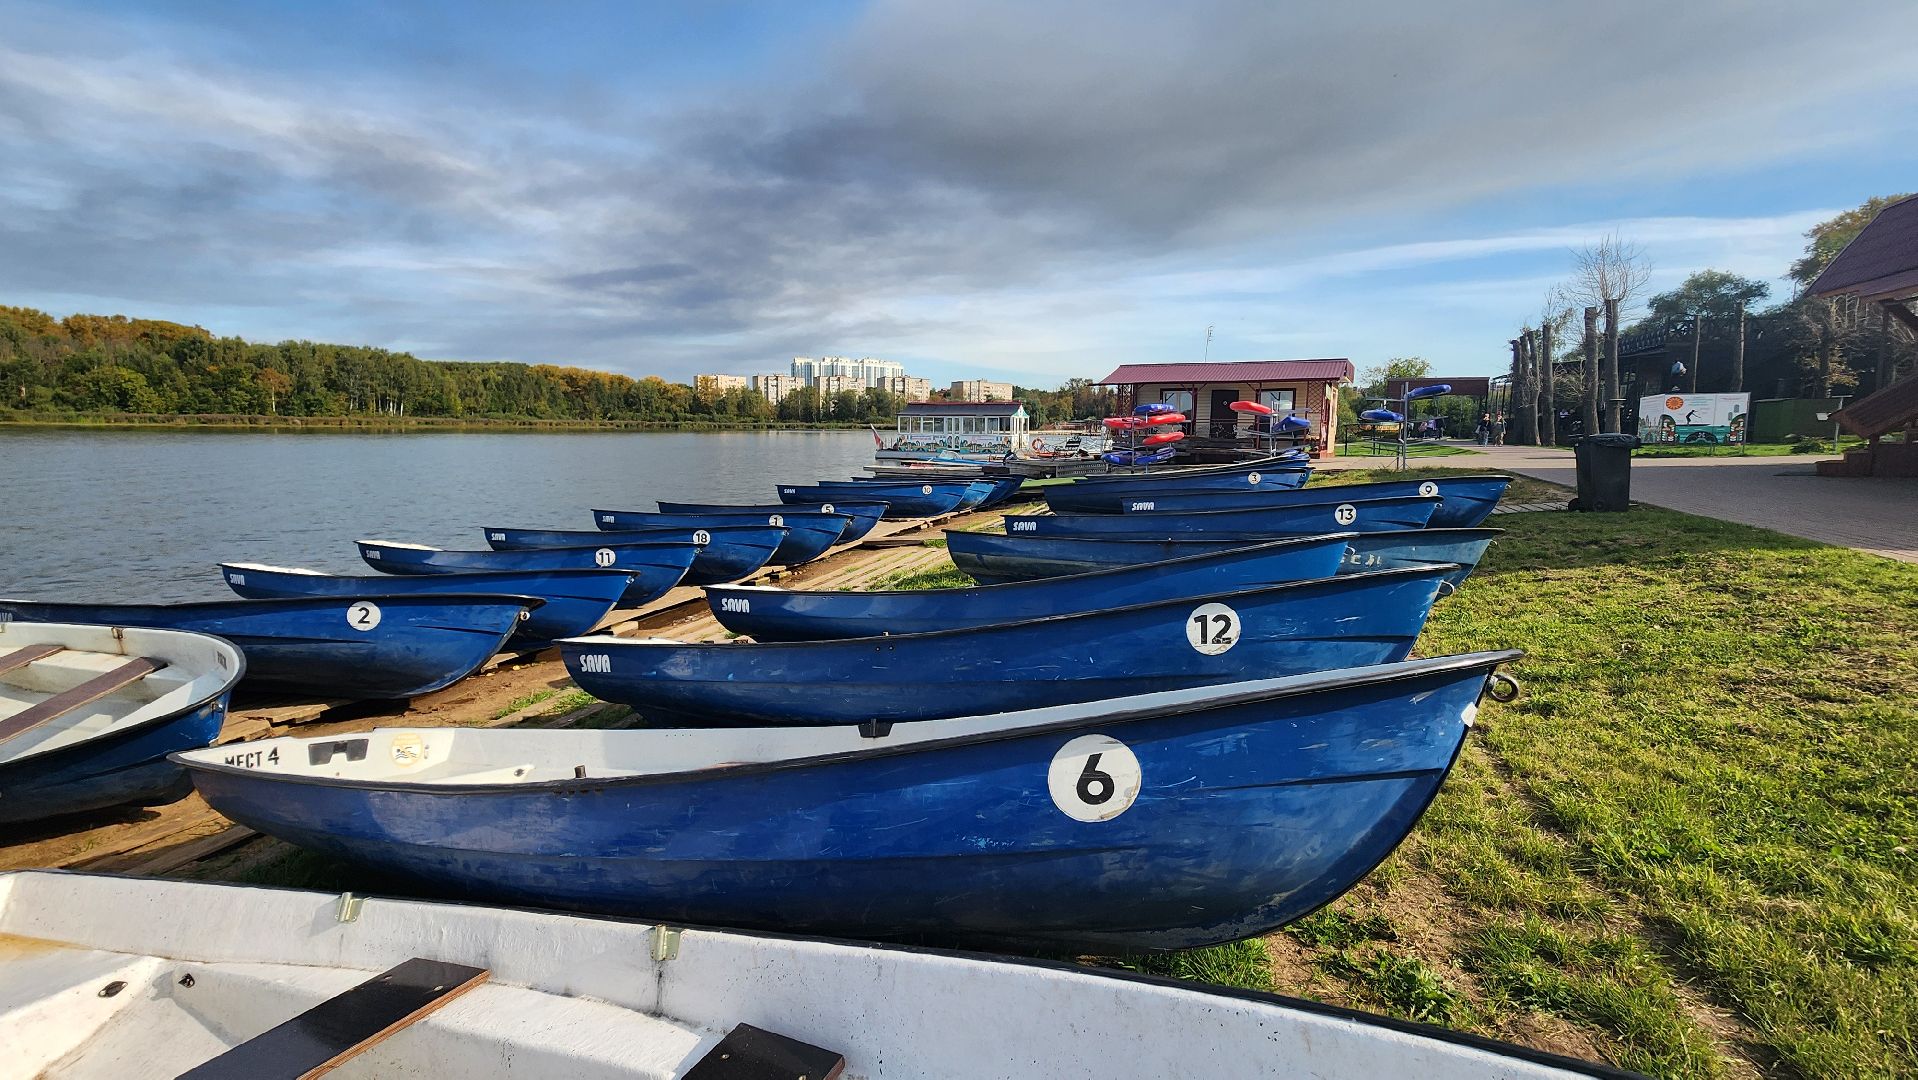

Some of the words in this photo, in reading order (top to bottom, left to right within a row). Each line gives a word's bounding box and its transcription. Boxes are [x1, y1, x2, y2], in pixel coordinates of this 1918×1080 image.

[1425, 485, 1433, 494] 9
[1131, 501, 1155, 511] SAVA
[1337, 508, 1354, 521] 13
[1013, 521, 1037, 531] SAVA
[695, 533, 708, 543] 18
[599, 552, 611, 564] 11
[229, 573, 245, 586] SAVA
[721, 597, 750, 613] SAVA
[357, 606, 370, 624] 2
[1194, 614, 1232, 644] 12
[579, 654, 611, 673] SAVA
[268, 746, 280, 765] 4
[1076, 752, 1115, 806] 6
